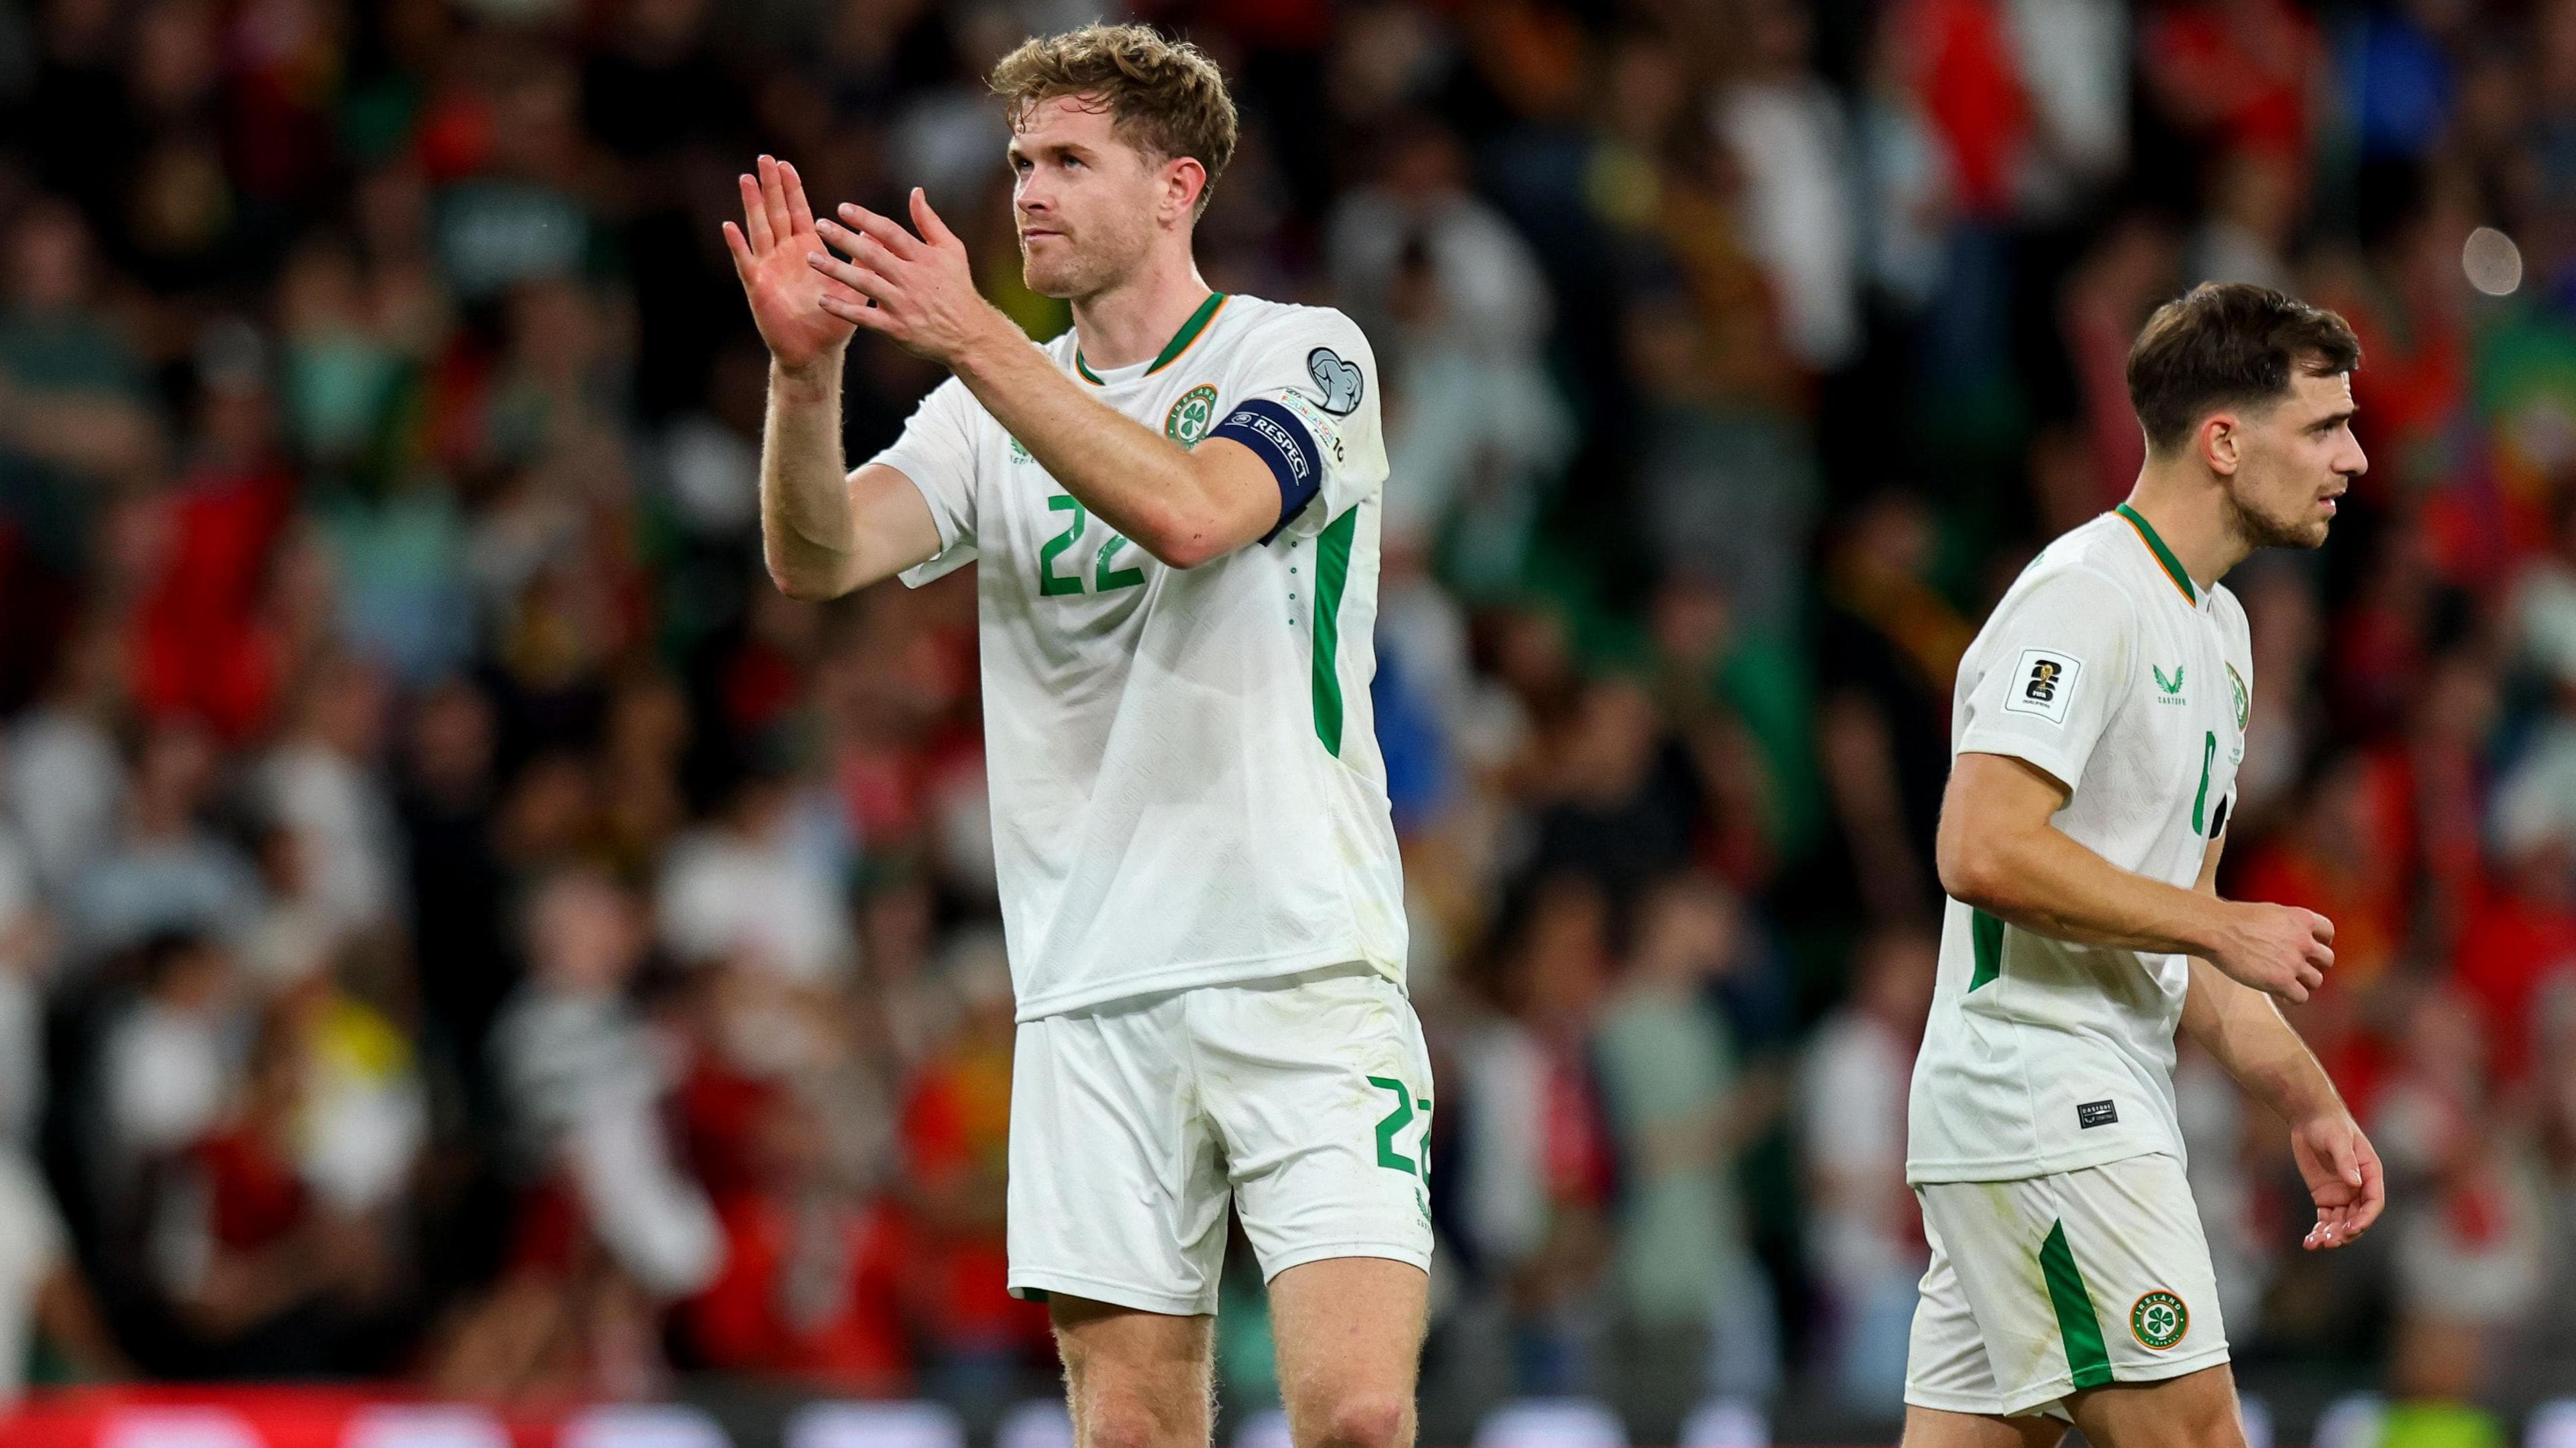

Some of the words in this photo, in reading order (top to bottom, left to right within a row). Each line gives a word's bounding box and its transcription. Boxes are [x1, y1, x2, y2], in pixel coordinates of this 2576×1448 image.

[1171, 388, 1216, 418] IRELAND
[1253, 419, 1307, 479] RESPECT
[1040, 495, 1146, 596] 22
[2135, 1295, 2182, 1315] IRELAND
